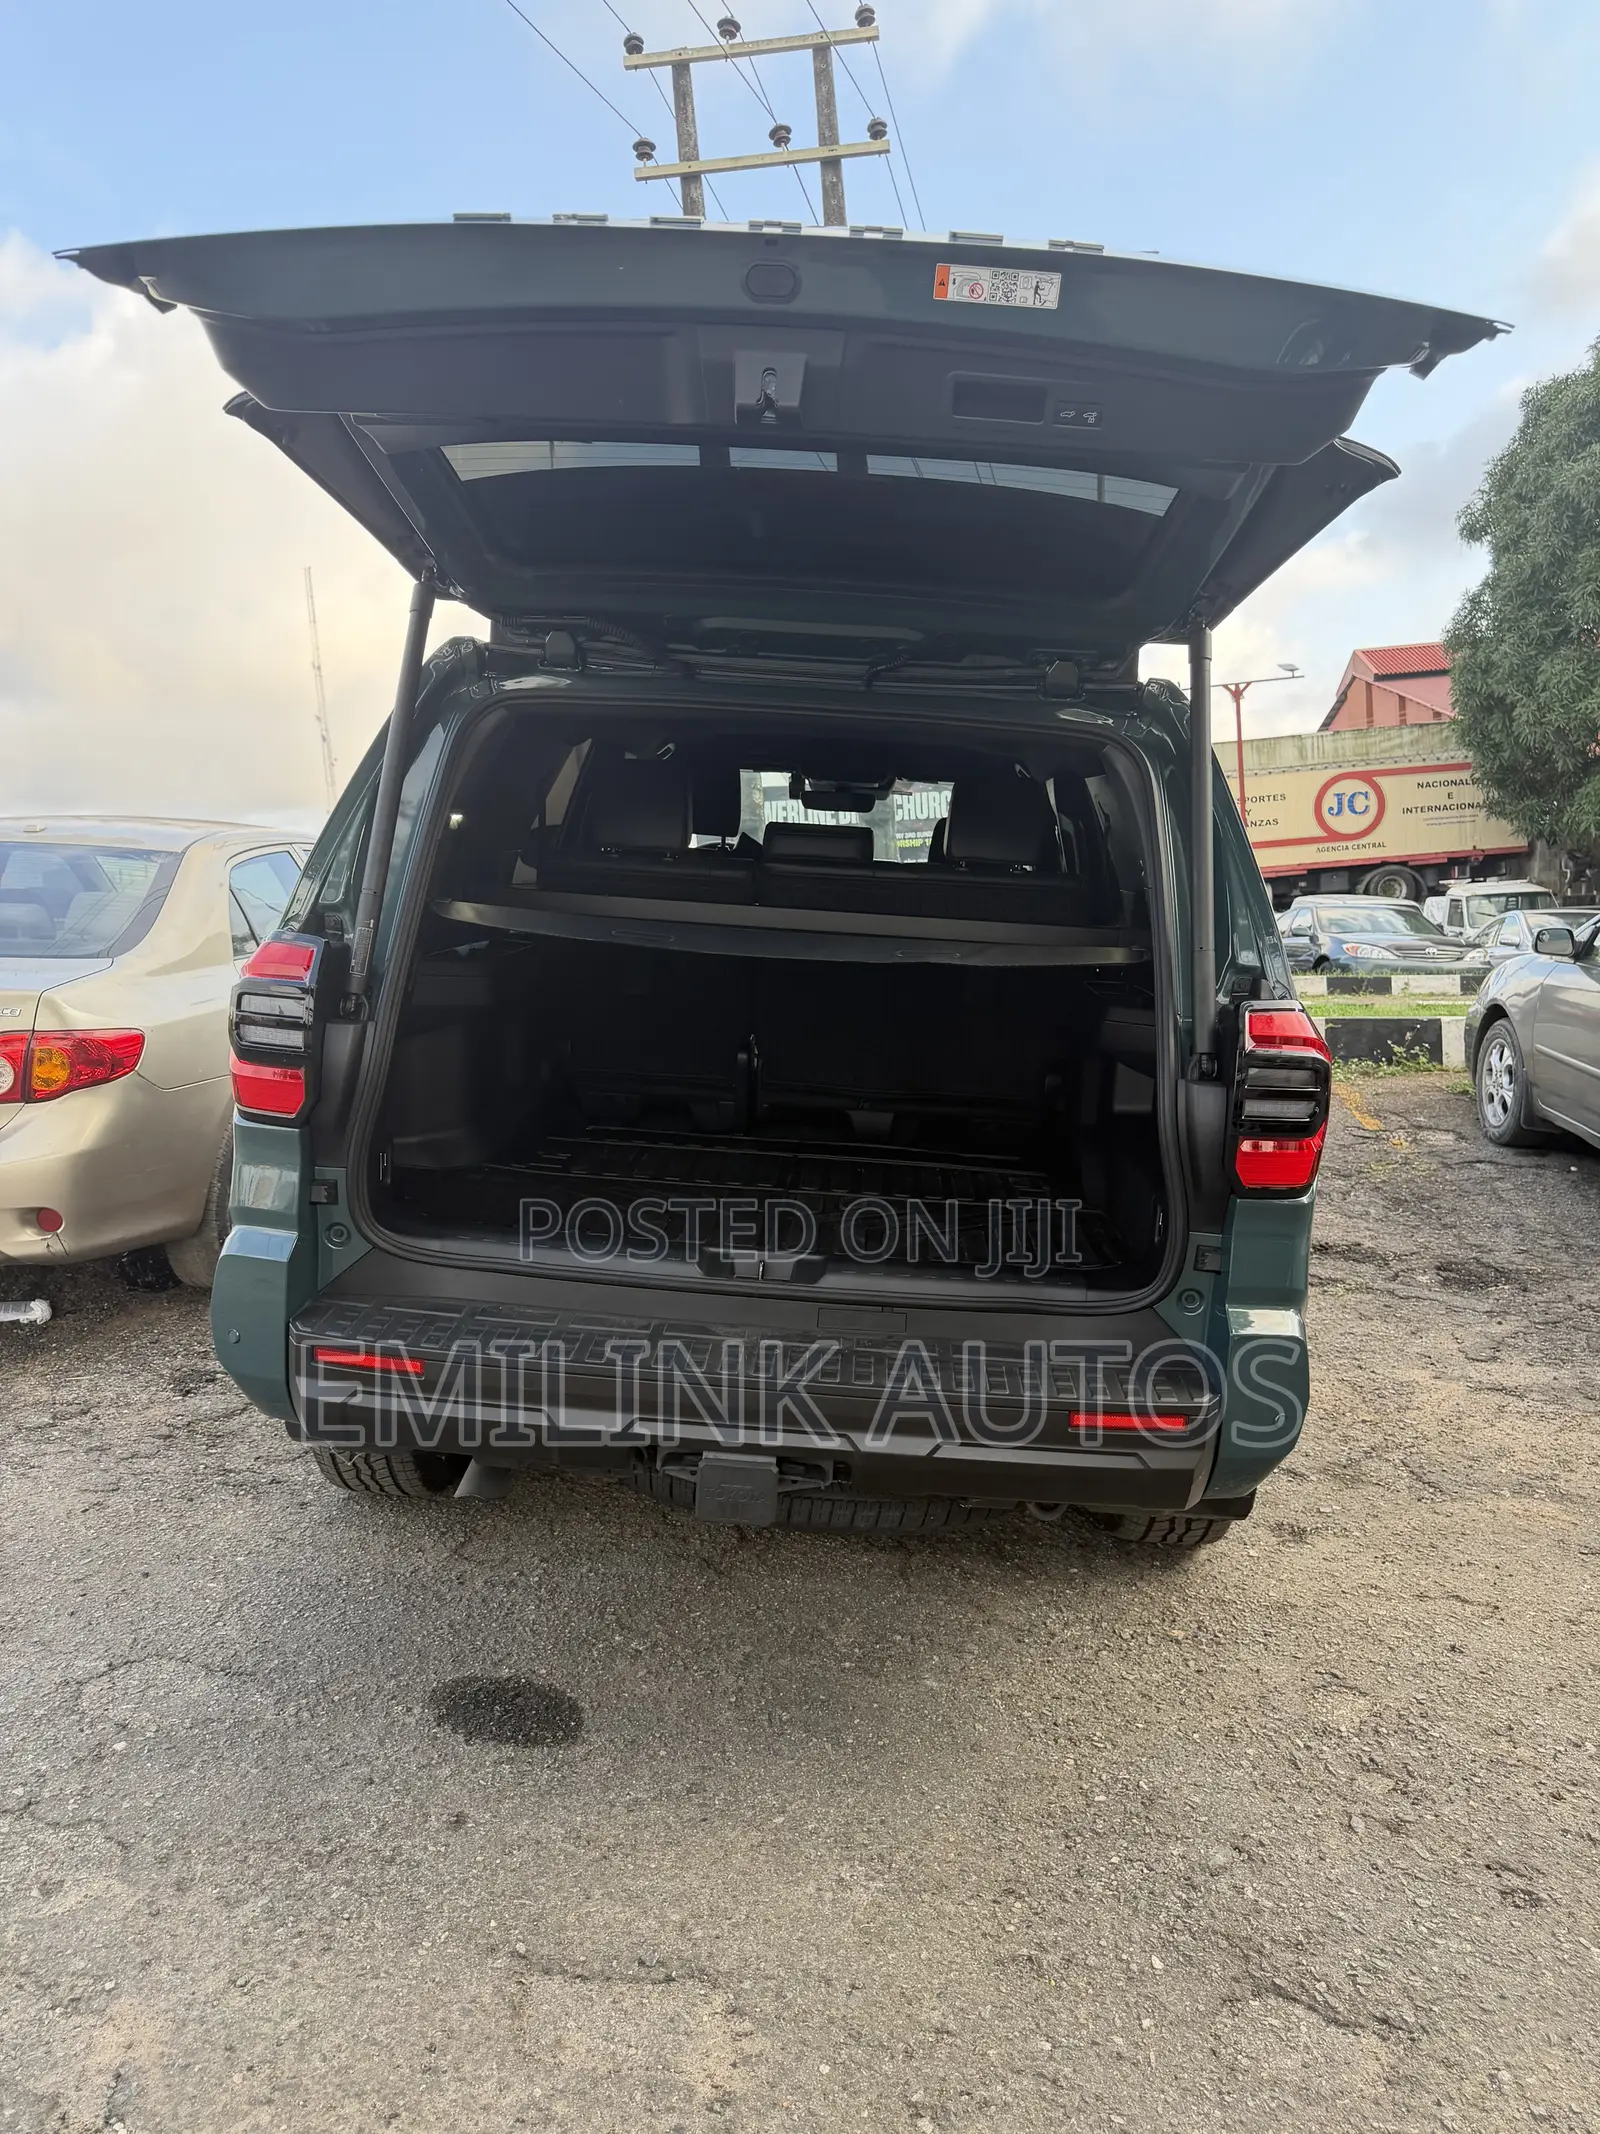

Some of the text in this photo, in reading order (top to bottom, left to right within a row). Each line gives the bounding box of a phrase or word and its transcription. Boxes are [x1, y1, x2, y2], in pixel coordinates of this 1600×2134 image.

[1447, 792, 1454, 800] E
[1327, 791, 1370, 817] JC
[1244, 808, 1252, 816] Y
[1246, 818, 1279, 828] NZAS
[1316, 841, 1387, 853] AGENCIA CENTRAL
